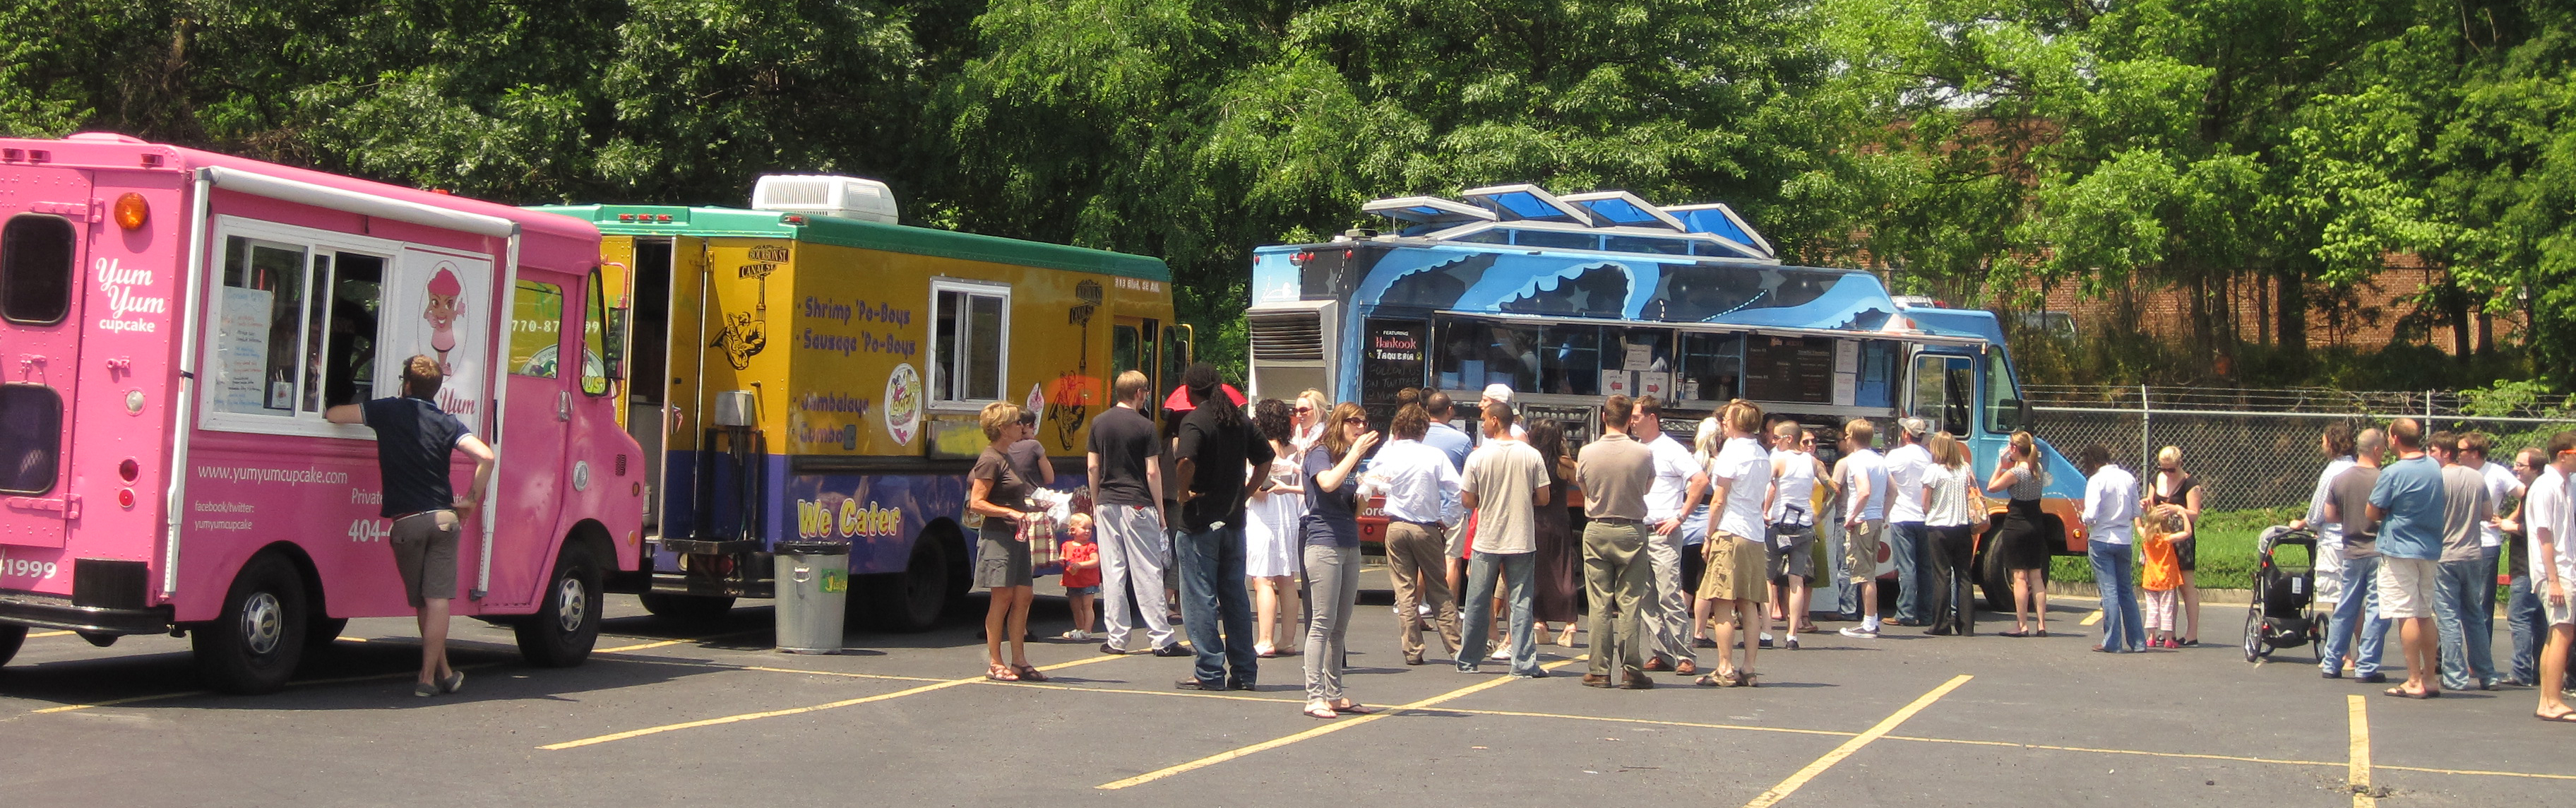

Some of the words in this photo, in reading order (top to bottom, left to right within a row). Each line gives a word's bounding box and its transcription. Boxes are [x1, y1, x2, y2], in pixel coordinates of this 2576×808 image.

[95, 257, 154, 292] Yum
[741, 264, 764, 277] CANAL
[107, 285, 167, 319] Yum
[804, 296, 852, 326] Shrimp
[99, 317, 156, 333] cupcake
[804, 328, 857, 357] Sausage
[1376, 336, 1417, 350] Hankook
[440, 387, 476, 415] Yum
[801, 390, 869, 419] Jambalaya
[799, 421, 844, 444] Gumbo
[198, 465, 348, 487] www.yumyumcupcake.com
[195, 501, 254, 513] facebook/twitter:
[797, 498, 833, 539] We
[839, 497, 901, 538] Cater
[195, 518, 253, 532] yumyumcupcake
